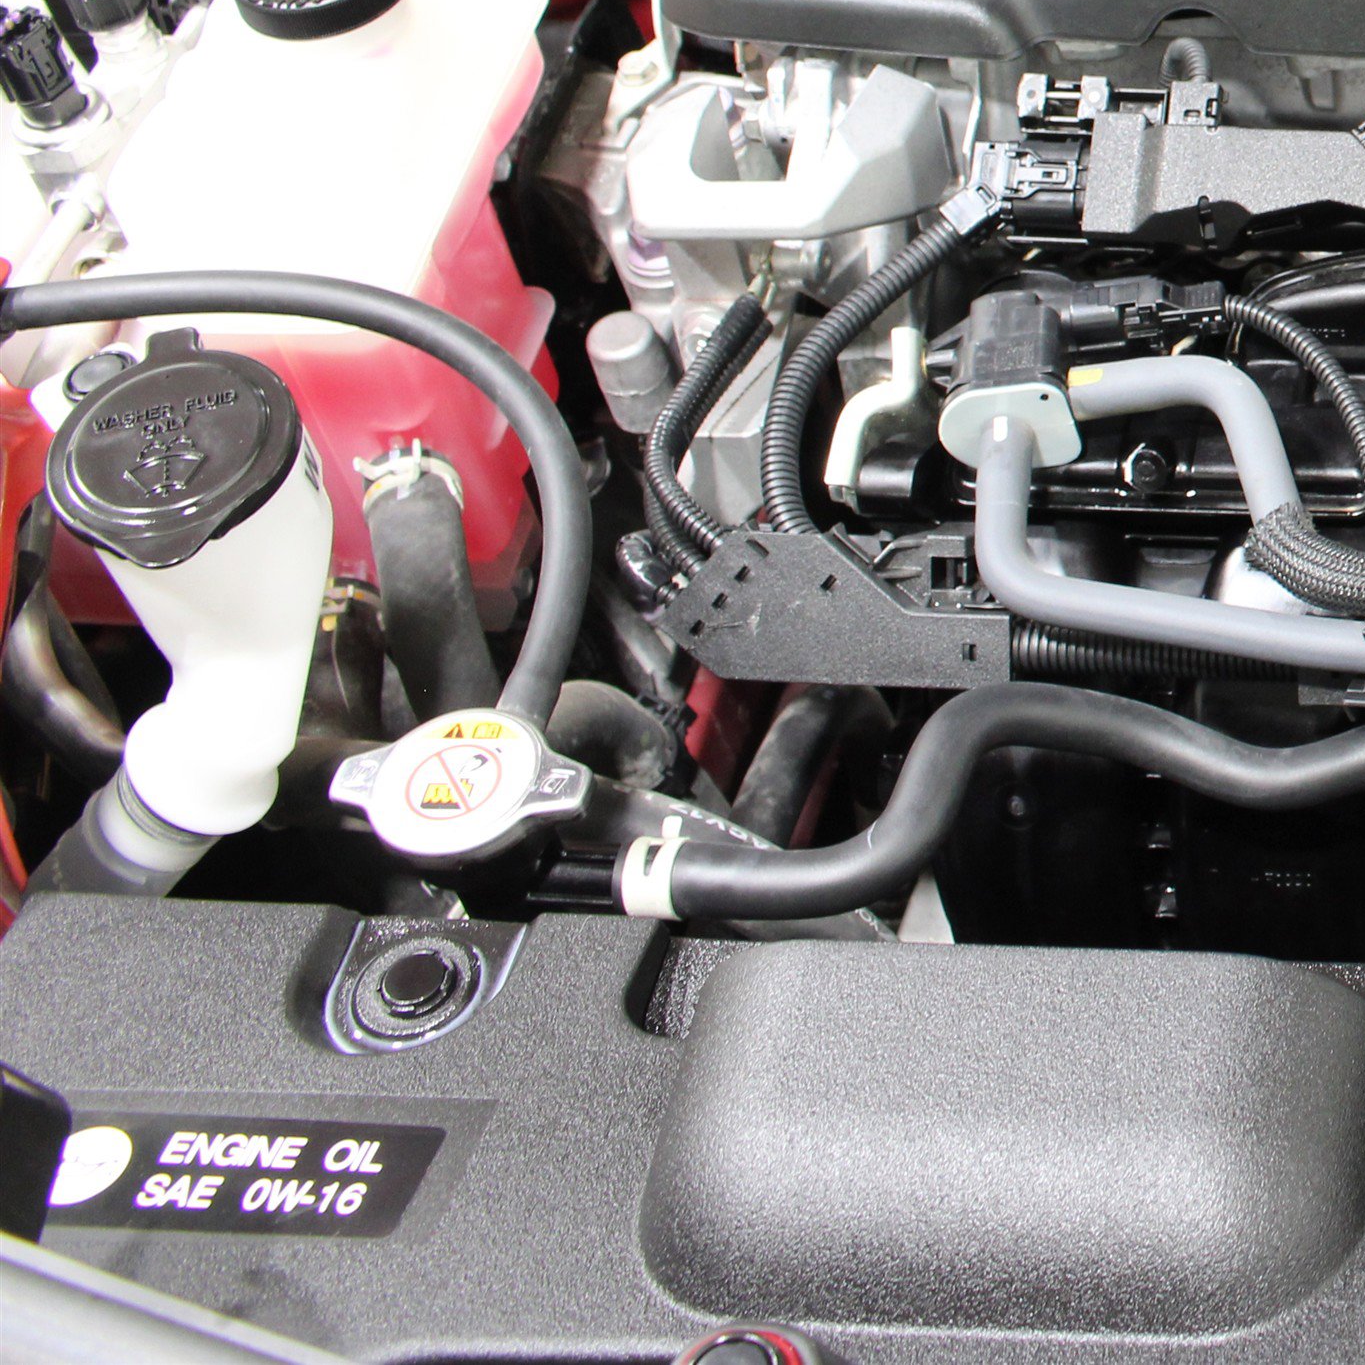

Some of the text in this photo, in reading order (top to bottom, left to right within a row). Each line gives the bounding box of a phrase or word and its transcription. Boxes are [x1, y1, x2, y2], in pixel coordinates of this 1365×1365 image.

[93, 389, 237, 434] WASHER FLUID
[141, 416, 190, 439] ONLY
[158, 1131, 384, 1173] ENGINE OIL
[133, 1174, 368, 1217] SAE 0W-16
